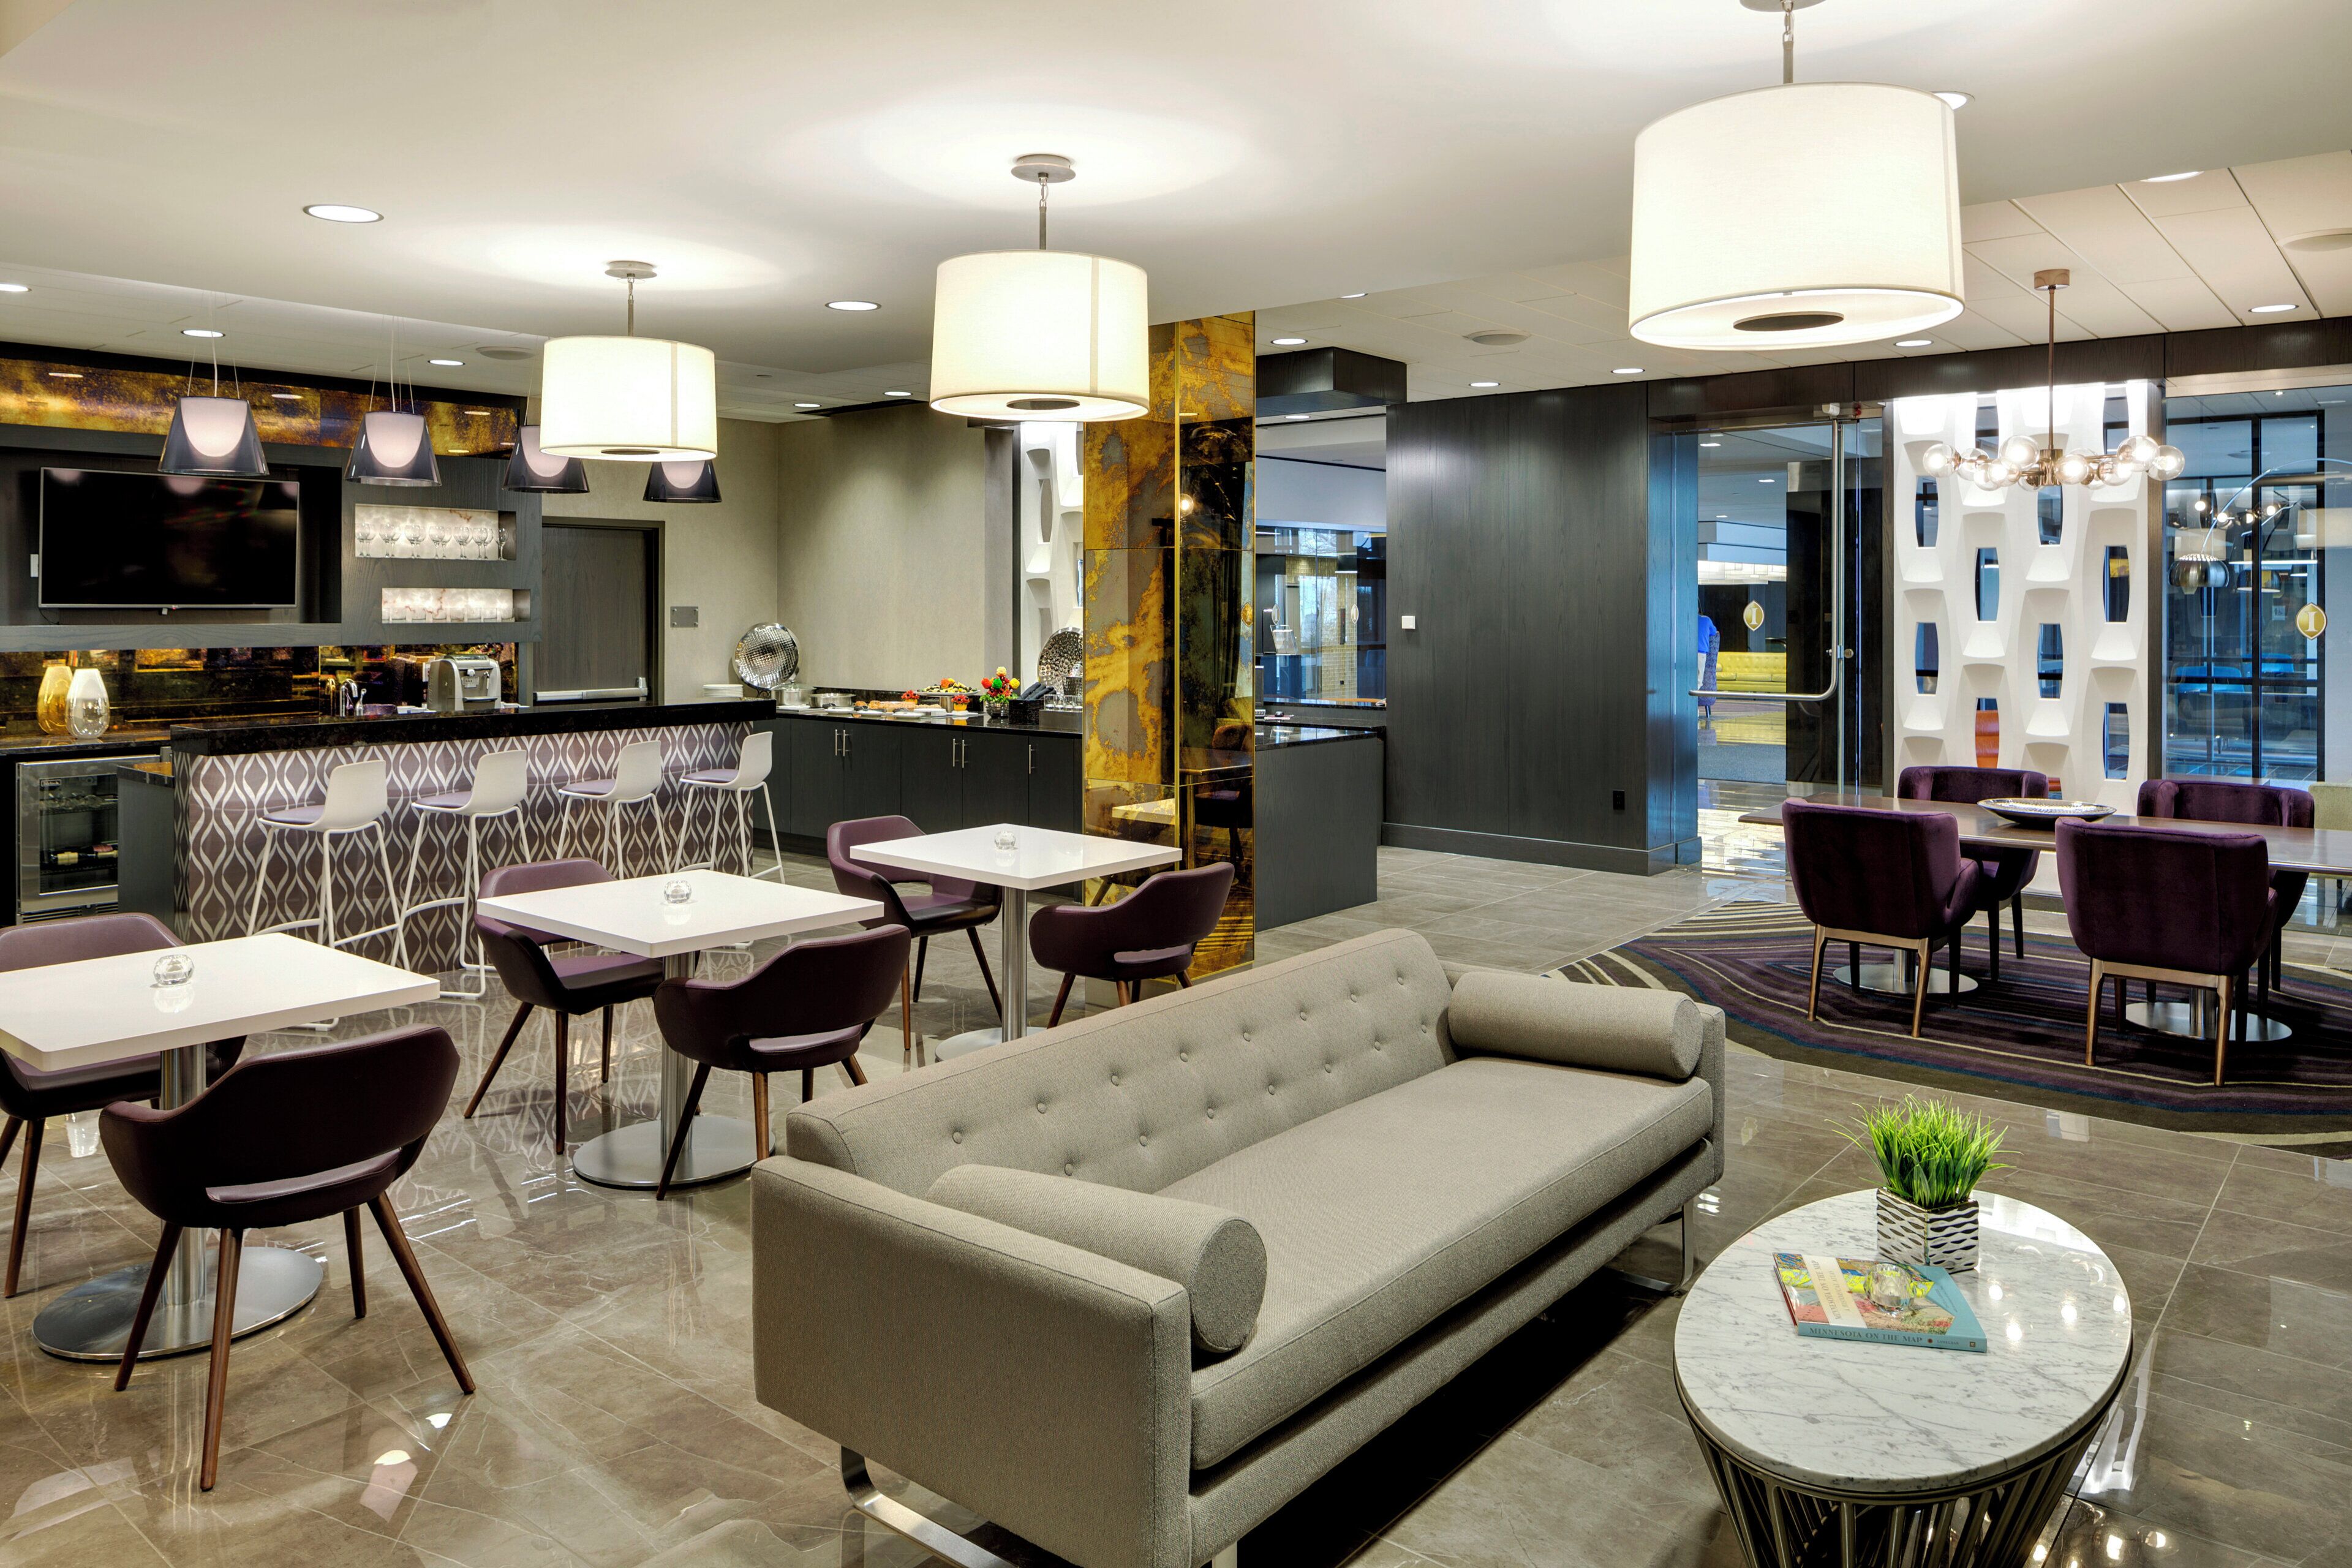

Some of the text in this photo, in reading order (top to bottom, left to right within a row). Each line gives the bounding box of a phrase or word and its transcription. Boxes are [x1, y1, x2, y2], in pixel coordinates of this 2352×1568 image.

[1749, 608, 1758, 625] I
[2304, 611, 2318, 631] I
[1811, 1260, 1842, 1319] MINNESOTA ON THE MAP
[1810, 1328, 1861, 1338] MINNESOTA
